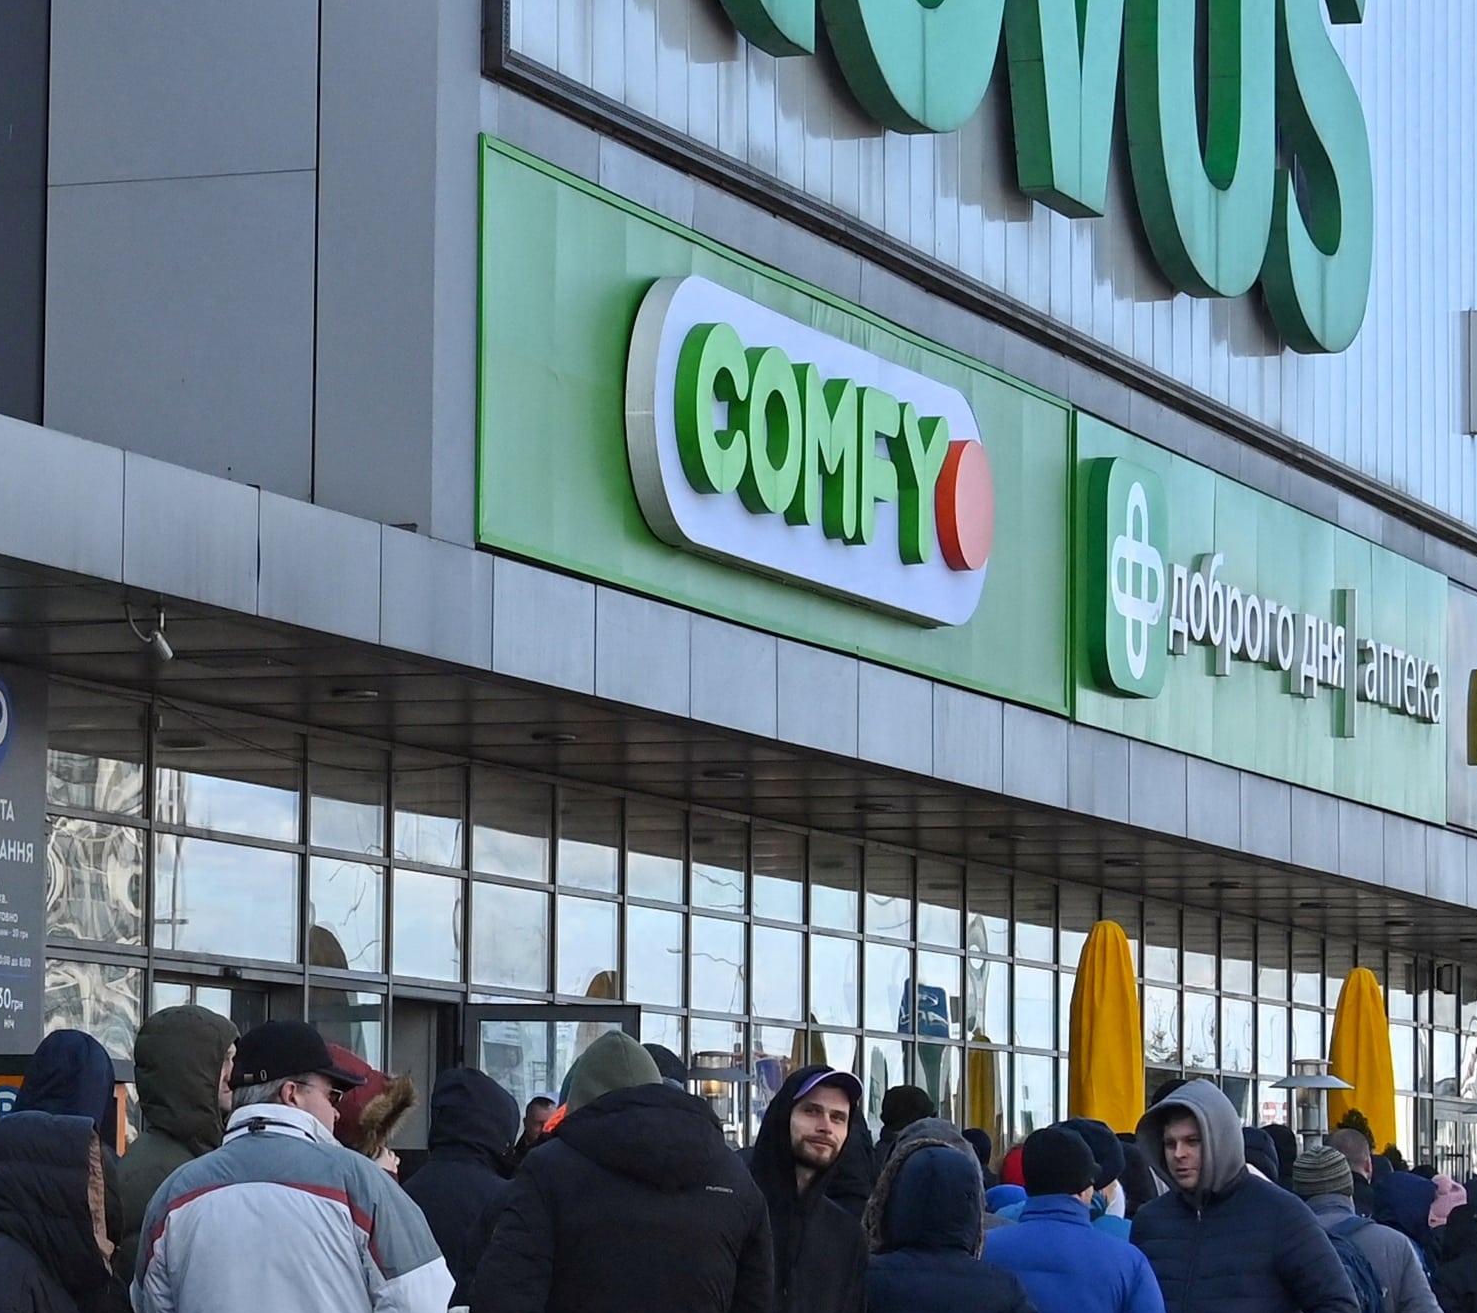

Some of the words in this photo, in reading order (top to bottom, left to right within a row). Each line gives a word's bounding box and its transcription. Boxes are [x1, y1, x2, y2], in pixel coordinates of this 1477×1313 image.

[674, 322, 949, 565] COMFY
[1167, 553, 1294, 676] доброго
[1292, 614, 1344, 698] дня
[1358, 638, 1442, 724] аптека
